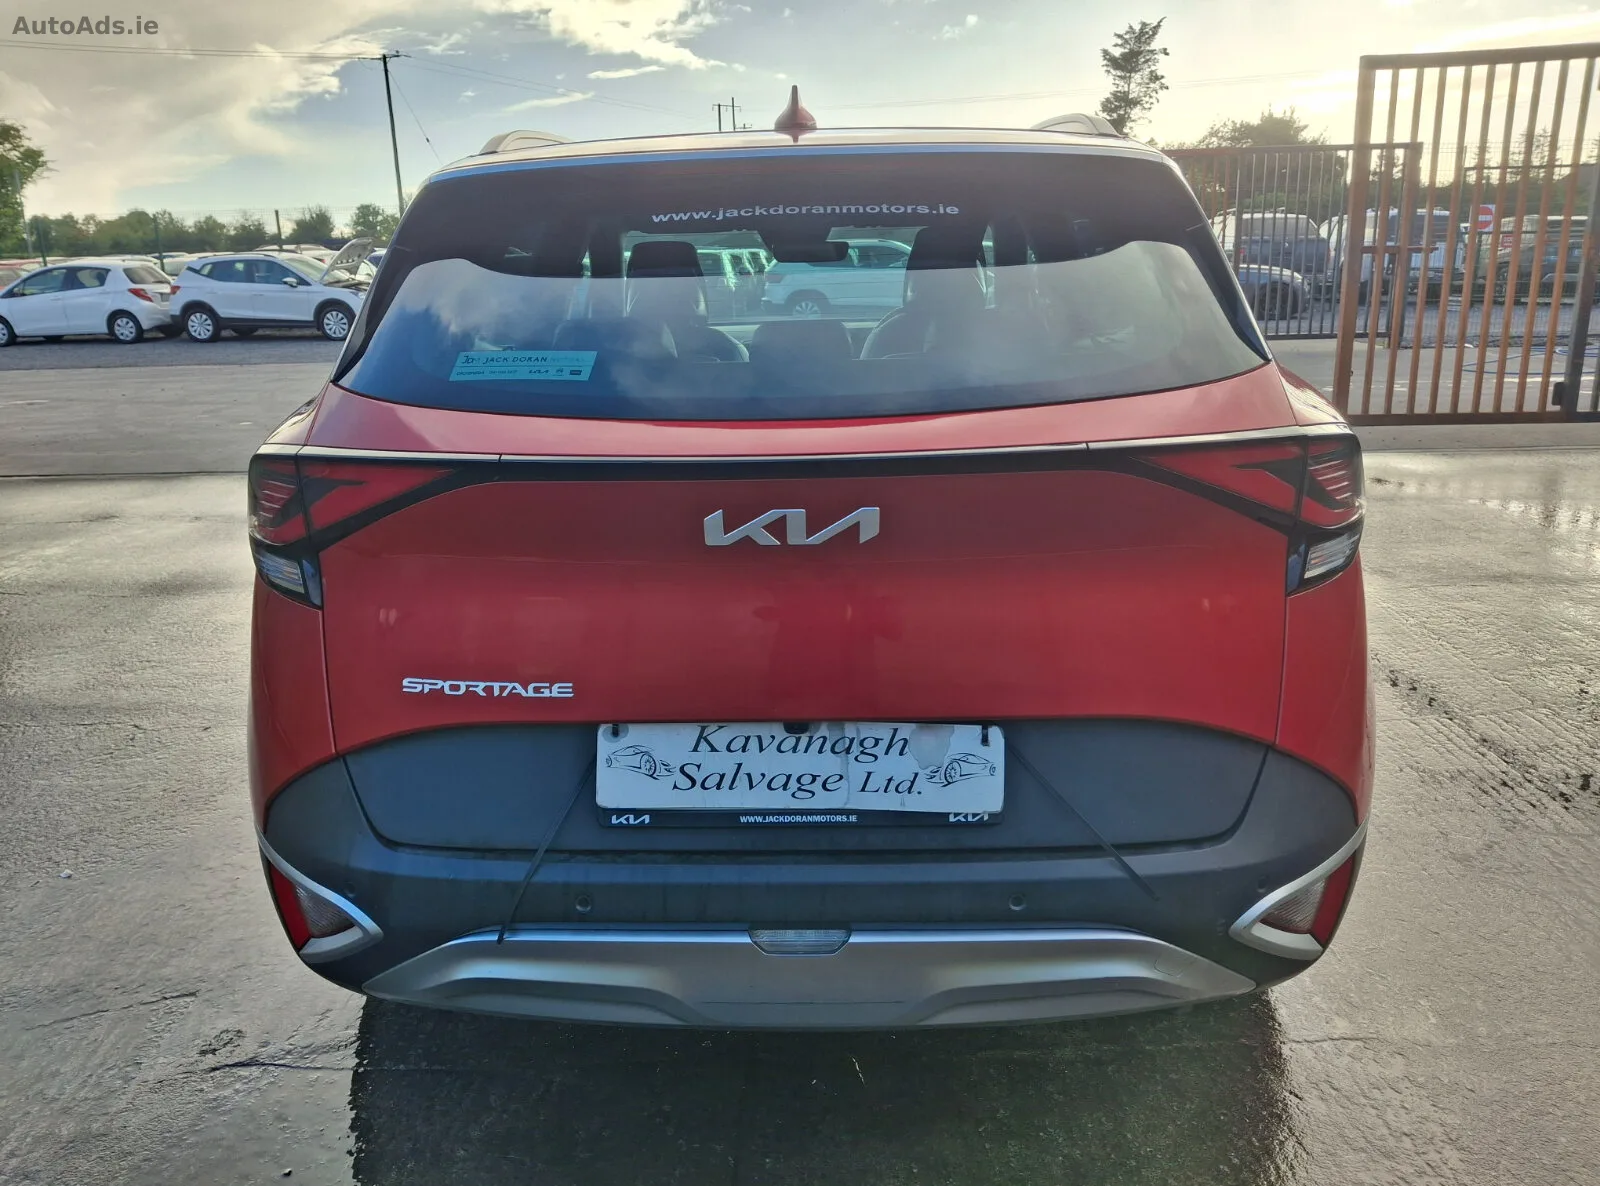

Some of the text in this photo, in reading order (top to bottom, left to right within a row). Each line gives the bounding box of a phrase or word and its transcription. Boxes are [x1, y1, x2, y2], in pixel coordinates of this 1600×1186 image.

[652, 203, 960, 223] www.jackdoranmotors.ie
[483, 356, 509, 364] JACK
[704, 507, 880, 546] KIA
[402, 677, 575, 698] SPORTAGE
[688, 724, 911, 763] Kavanagh
[672, 762, 925, 800] Salvage Ltd.
[611, 814, 650, 825] KIA
[739, 814, 858, 824] WWW.JACKDORANMOTORS.IE
